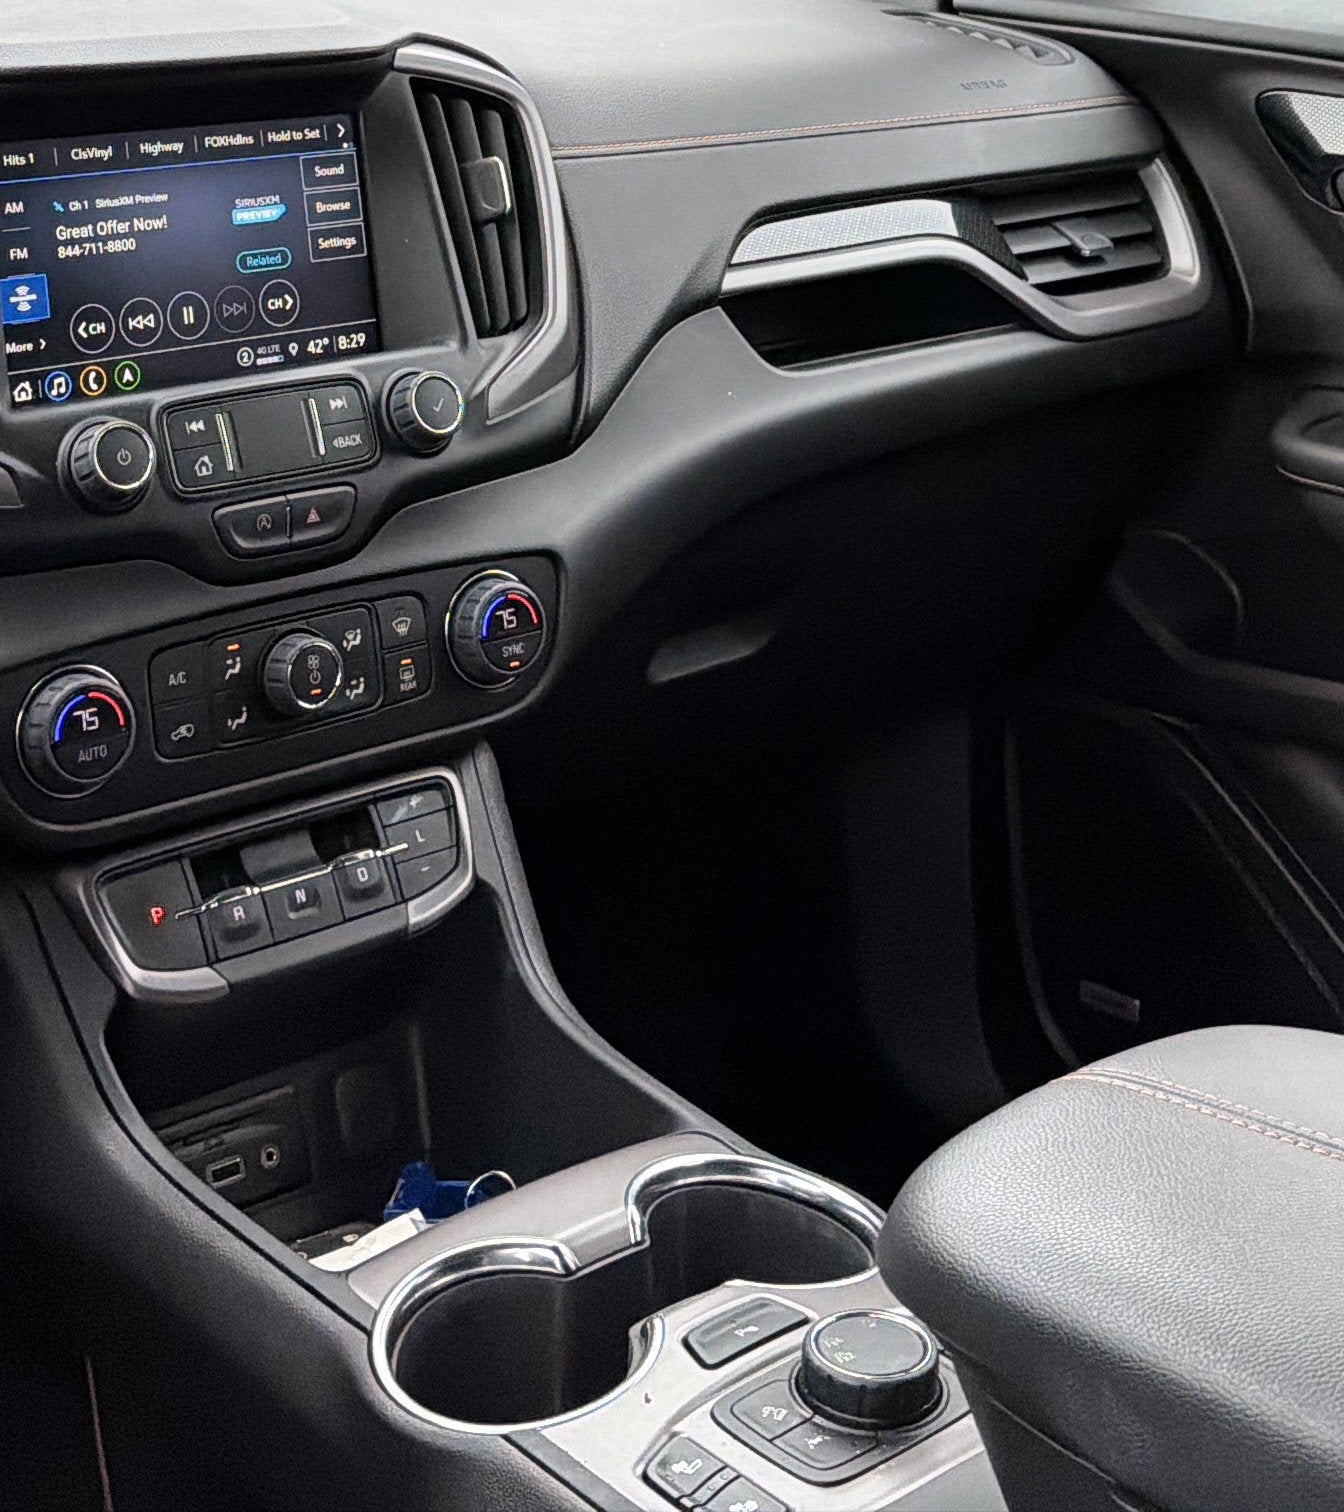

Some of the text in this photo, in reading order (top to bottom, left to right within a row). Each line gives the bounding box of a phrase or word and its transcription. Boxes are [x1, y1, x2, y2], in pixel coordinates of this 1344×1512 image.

[268, 128, 320, 142] Hold to Set
[140, 141, 185, 156] Highway
[3, 153, 35, 166] Hits 1
[314, 164, 345, 177] Sound
[4, 201, 24, 215] AM
[69, 201, 82, 211] Ch
[135, 192, 169, 204] Preview
[316, 200, 351, 213] Browse
[56, 214, 168, 240] Great Offer Now!
[57, 238, 136, 259] 844-711-8800
[318, 236, 357, 250] Settings
[9, 247, 29, 260] FM
[246, 253, 282, 267] Related
[267, 297, 283, 310] CH
[88, 322, 106, 335] CH
[6, 342, 33, 354] More
[267, 344, 281, 354] LTE
[307, 337, 330, 354] 42°
[338, 332, 366, 350] 8:29
[338, 433, 363, 448] BACK
[495, 608, 517, 630] 75
[502, 642, 525, 658] SYNC
[168, 671, 187, 686] A/C
[72, 707, 99, 731] 75
[78, 744, 108, 763] AUTO
[150, 829, 426, 926] P R N D L
